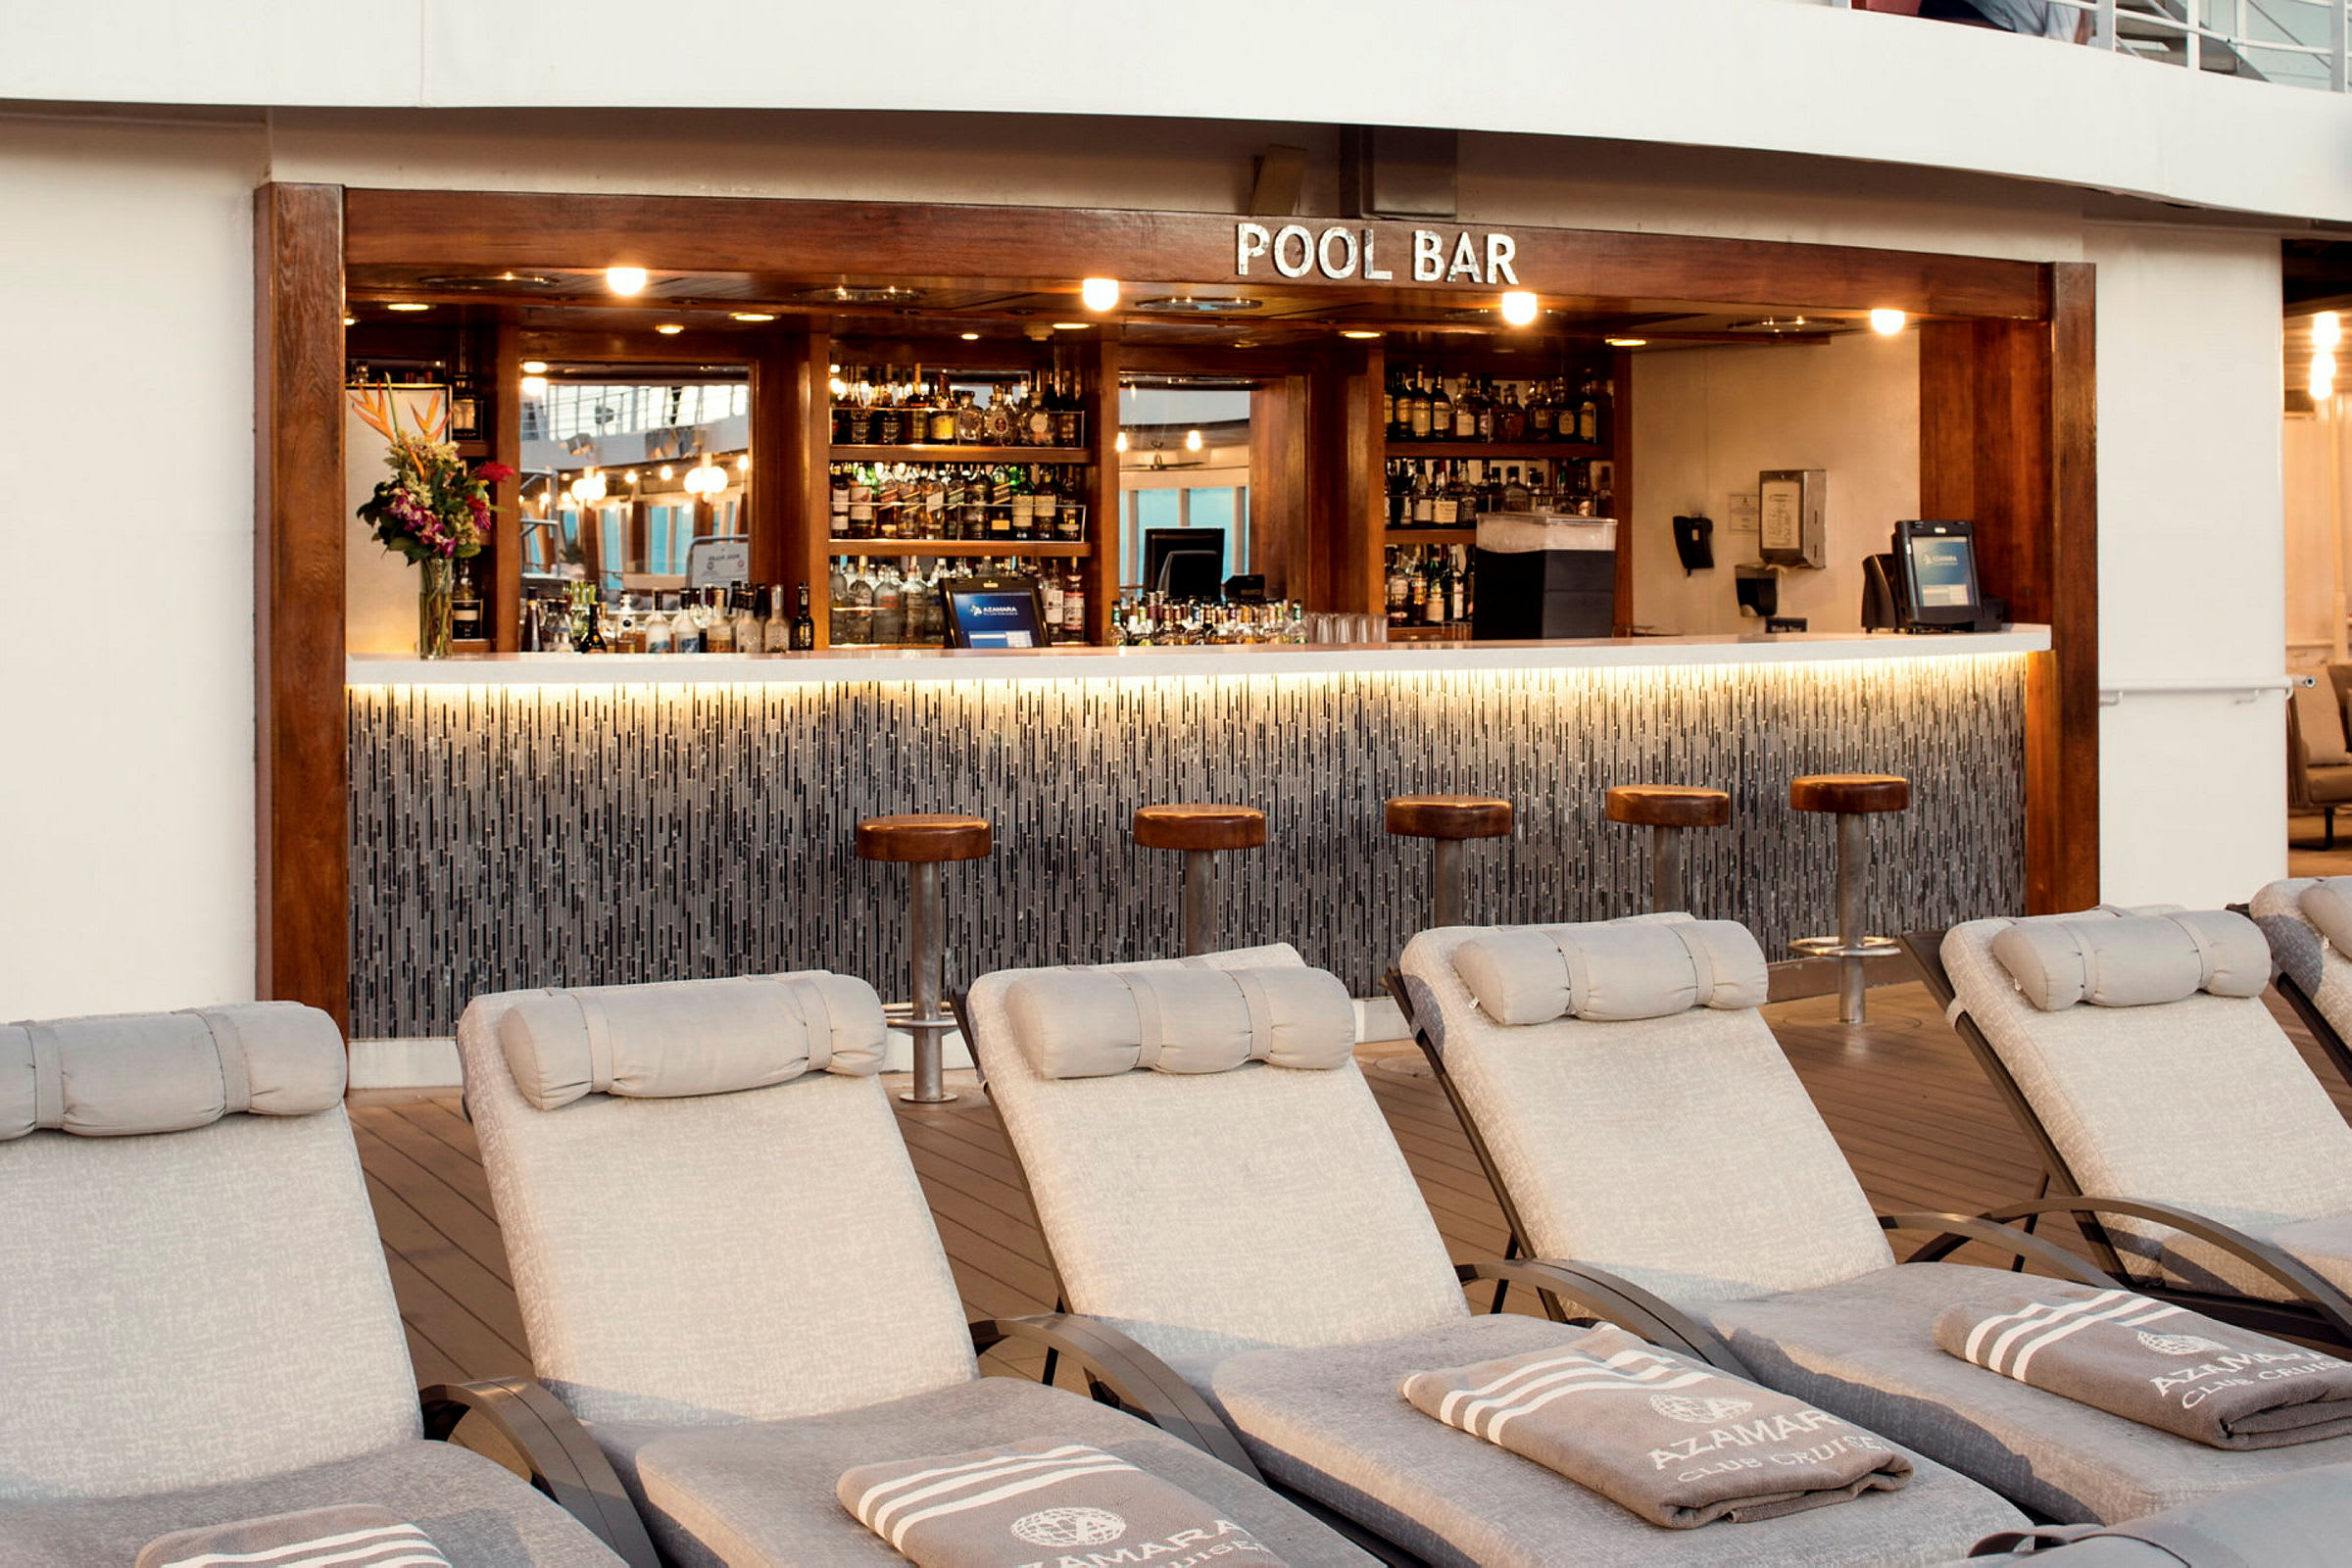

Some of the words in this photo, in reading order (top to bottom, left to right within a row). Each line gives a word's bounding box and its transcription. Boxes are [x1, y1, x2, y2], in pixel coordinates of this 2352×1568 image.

[1236, 222, 1393, 280] POOL
[1414, 229, 1519, 285] BAR
[2181, 1379, 2254, 1409] CLUB
[1647, 1409, 1840, 1470] AZAMAR
[1677, 1457, 1763, 1482] CLUB
